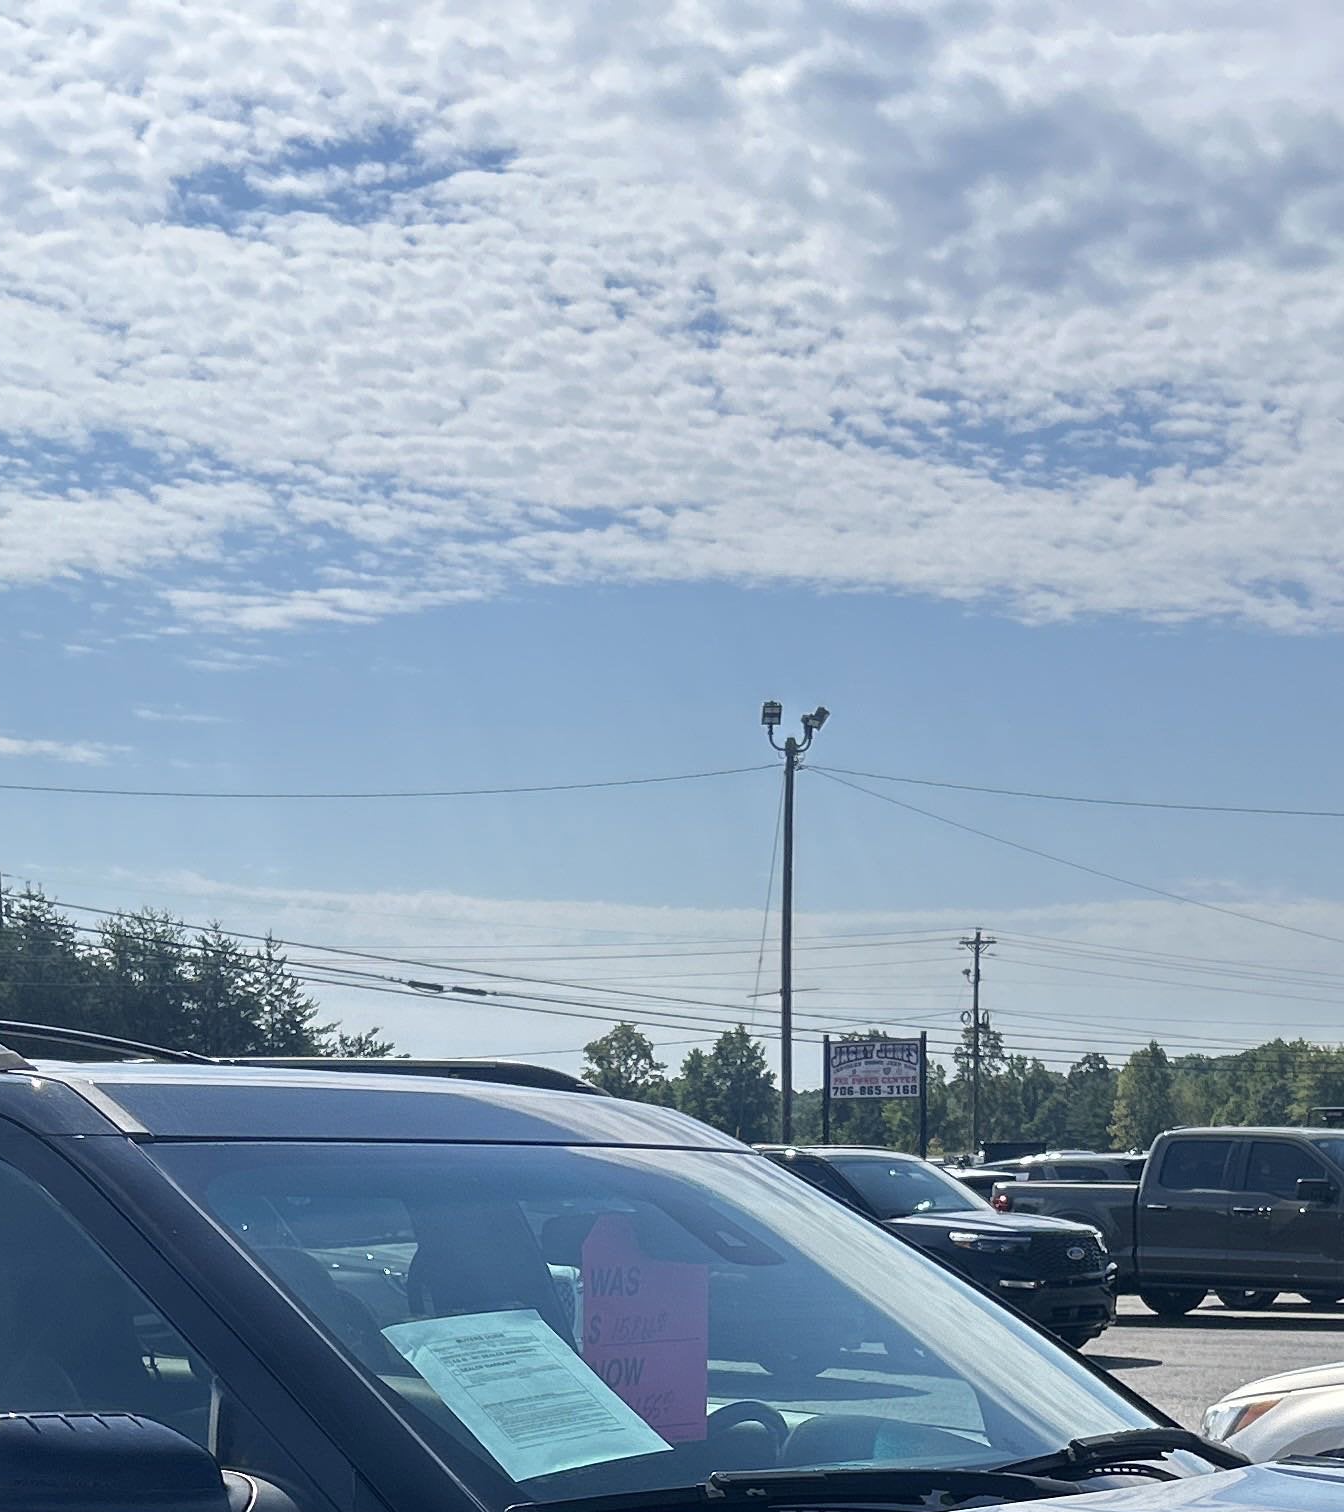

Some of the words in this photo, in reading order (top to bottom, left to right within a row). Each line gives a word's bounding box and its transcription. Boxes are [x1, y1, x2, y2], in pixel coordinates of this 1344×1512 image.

[831, 1044, 875, 1067] JACKY
[876, 1043, 919, 1066] JONES
[590, 1265, 641, 1297] WAS
